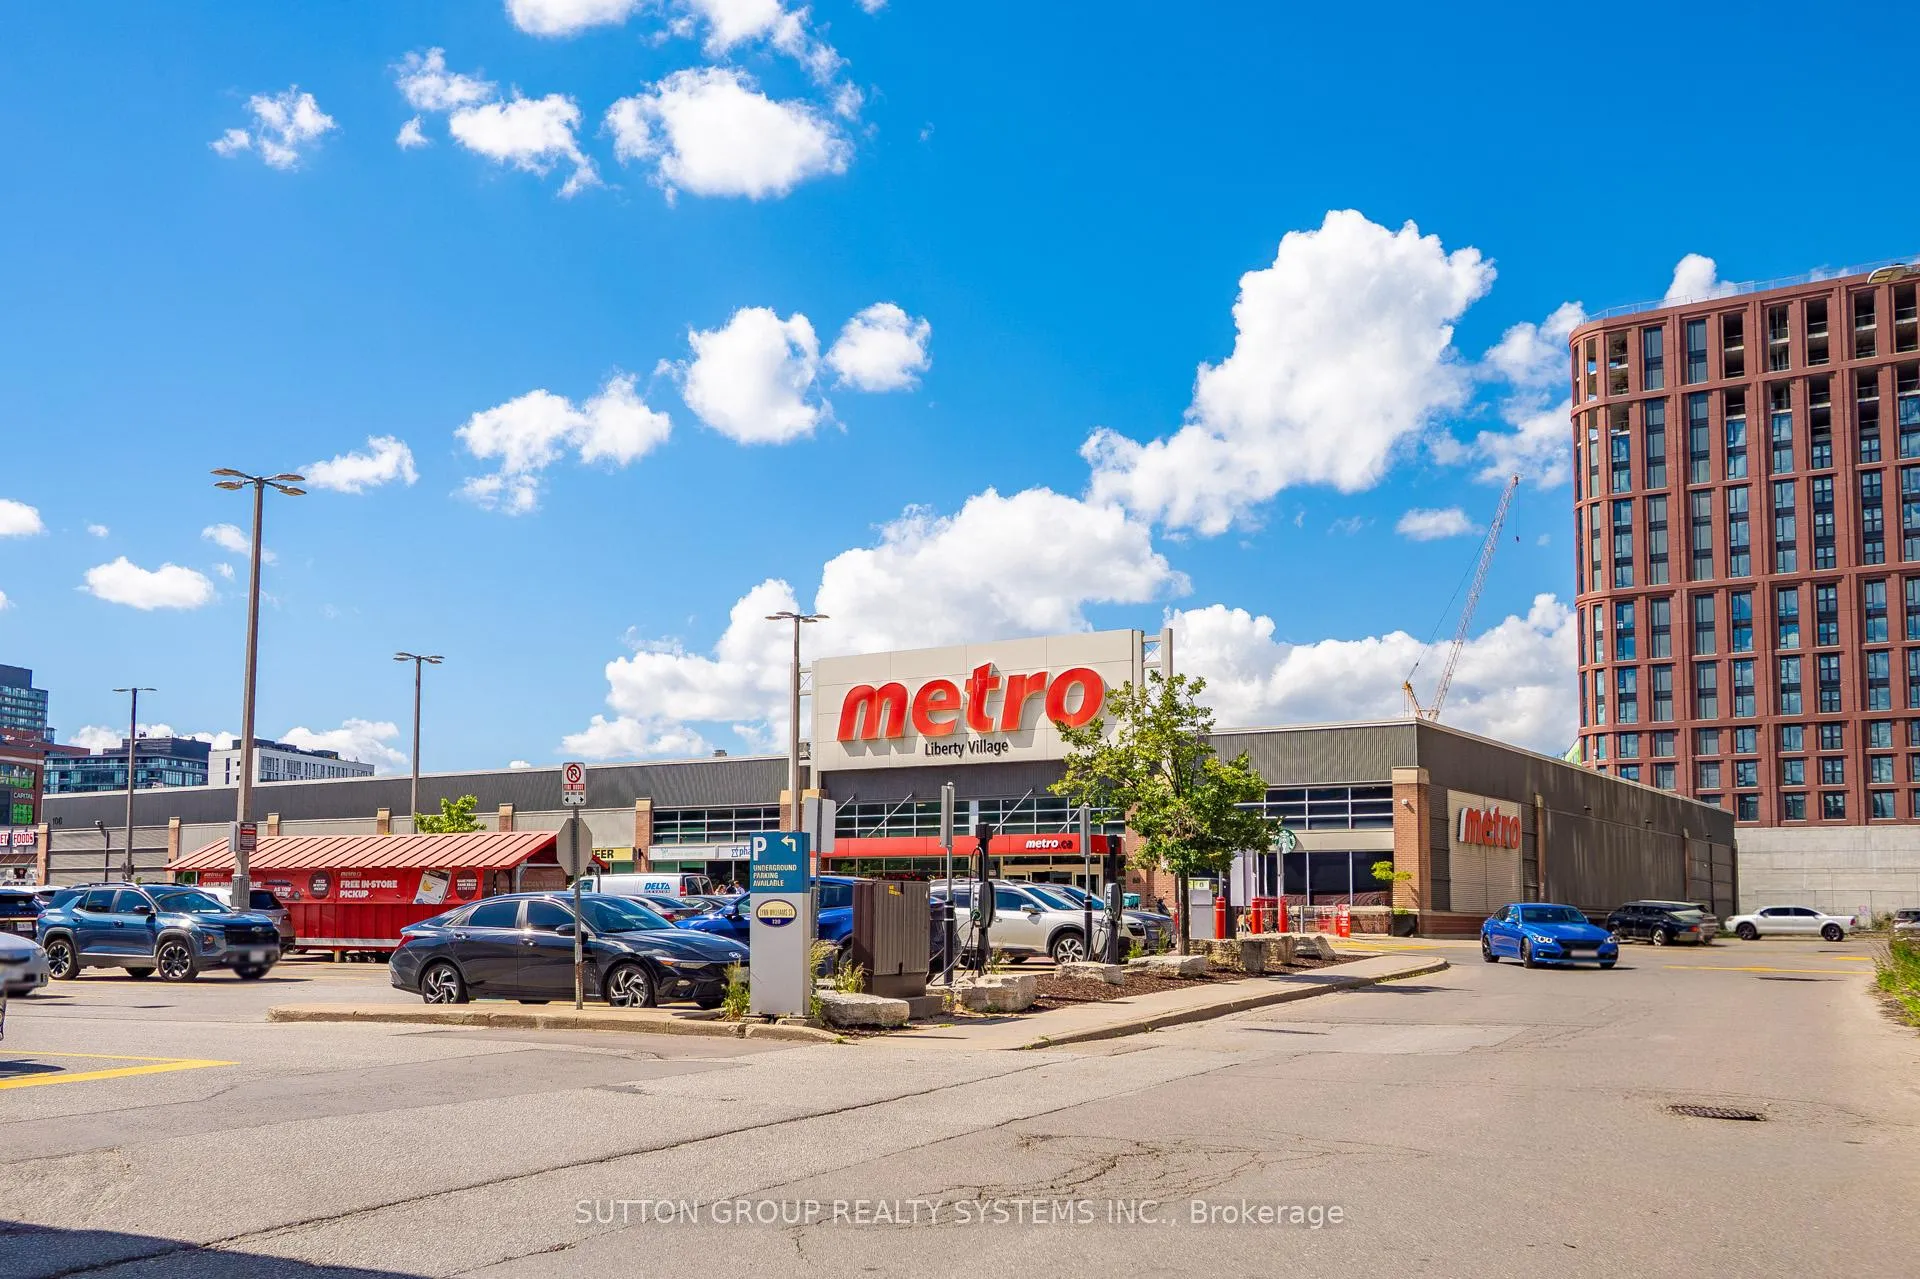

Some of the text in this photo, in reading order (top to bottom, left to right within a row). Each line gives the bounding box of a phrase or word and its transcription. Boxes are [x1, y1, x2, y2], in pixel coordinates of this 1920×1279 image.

[837, 662, 1105, 741] metro
[924, 739, 1008, 757] Liberty Village
[1460, 806, 1520, 849] metro
[13, 833, 34, 844] FOODS
[753, 836, 767, 861] P
[1025, 839, 1073, 850] metro.ca
[340, 880, 398, 888] FREE IN-STORE
[644, 882, 671, 890] DELTA
[339, 890, 369, 898] PICKUP
